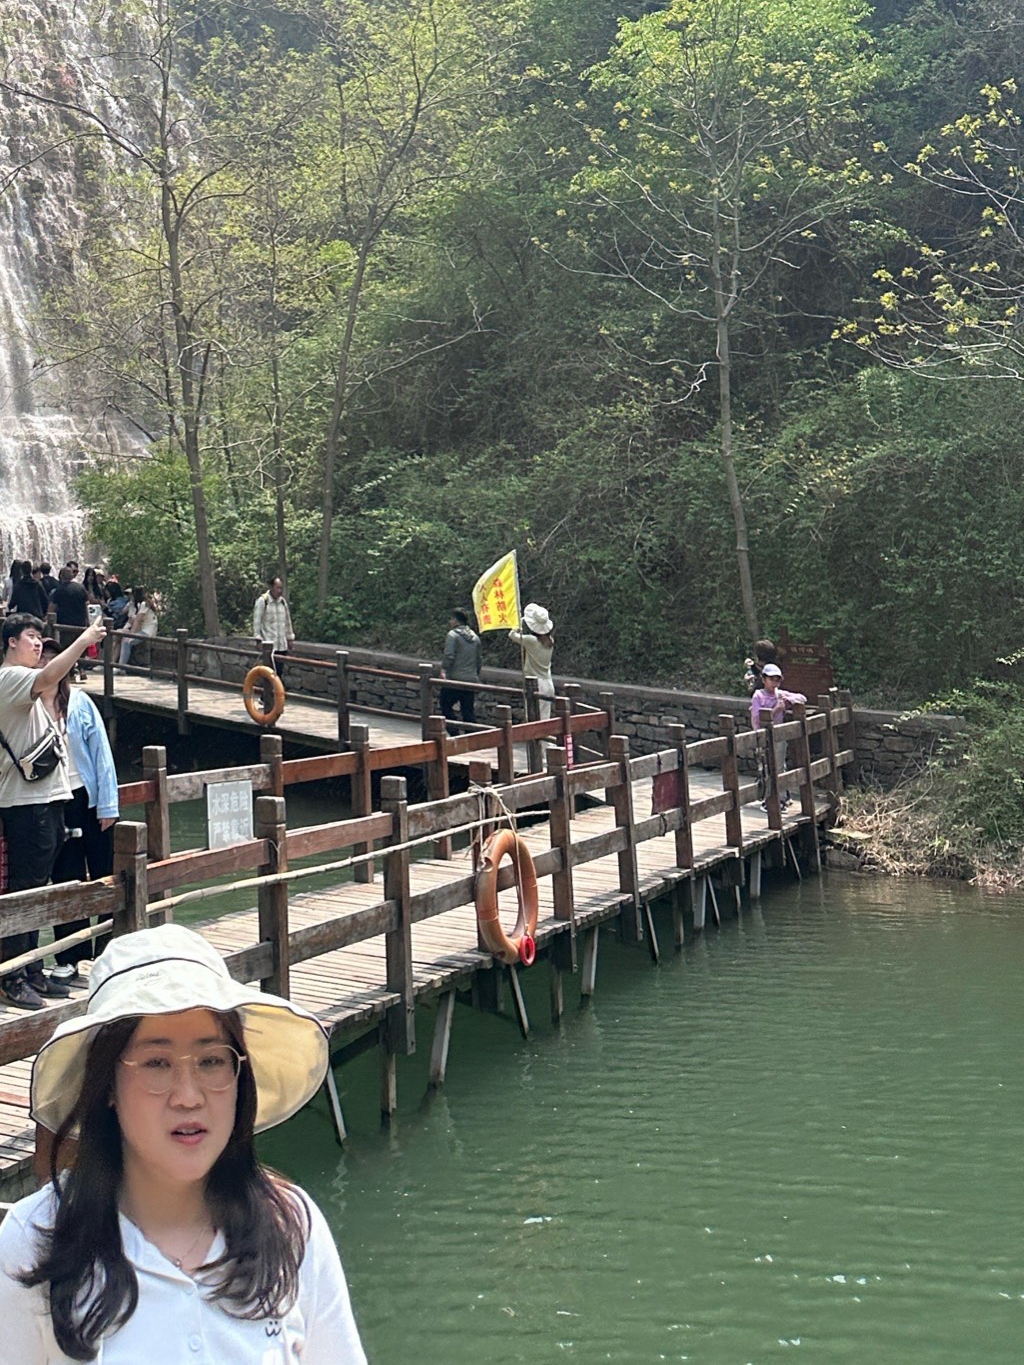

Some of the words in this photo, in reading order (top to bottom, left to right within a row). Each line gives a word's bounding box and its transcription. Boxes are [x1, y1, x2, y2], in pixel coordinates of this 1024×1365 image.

[492, 577, 509, 623] 森林防火
[212, 791, 248, 815] 水深危险
